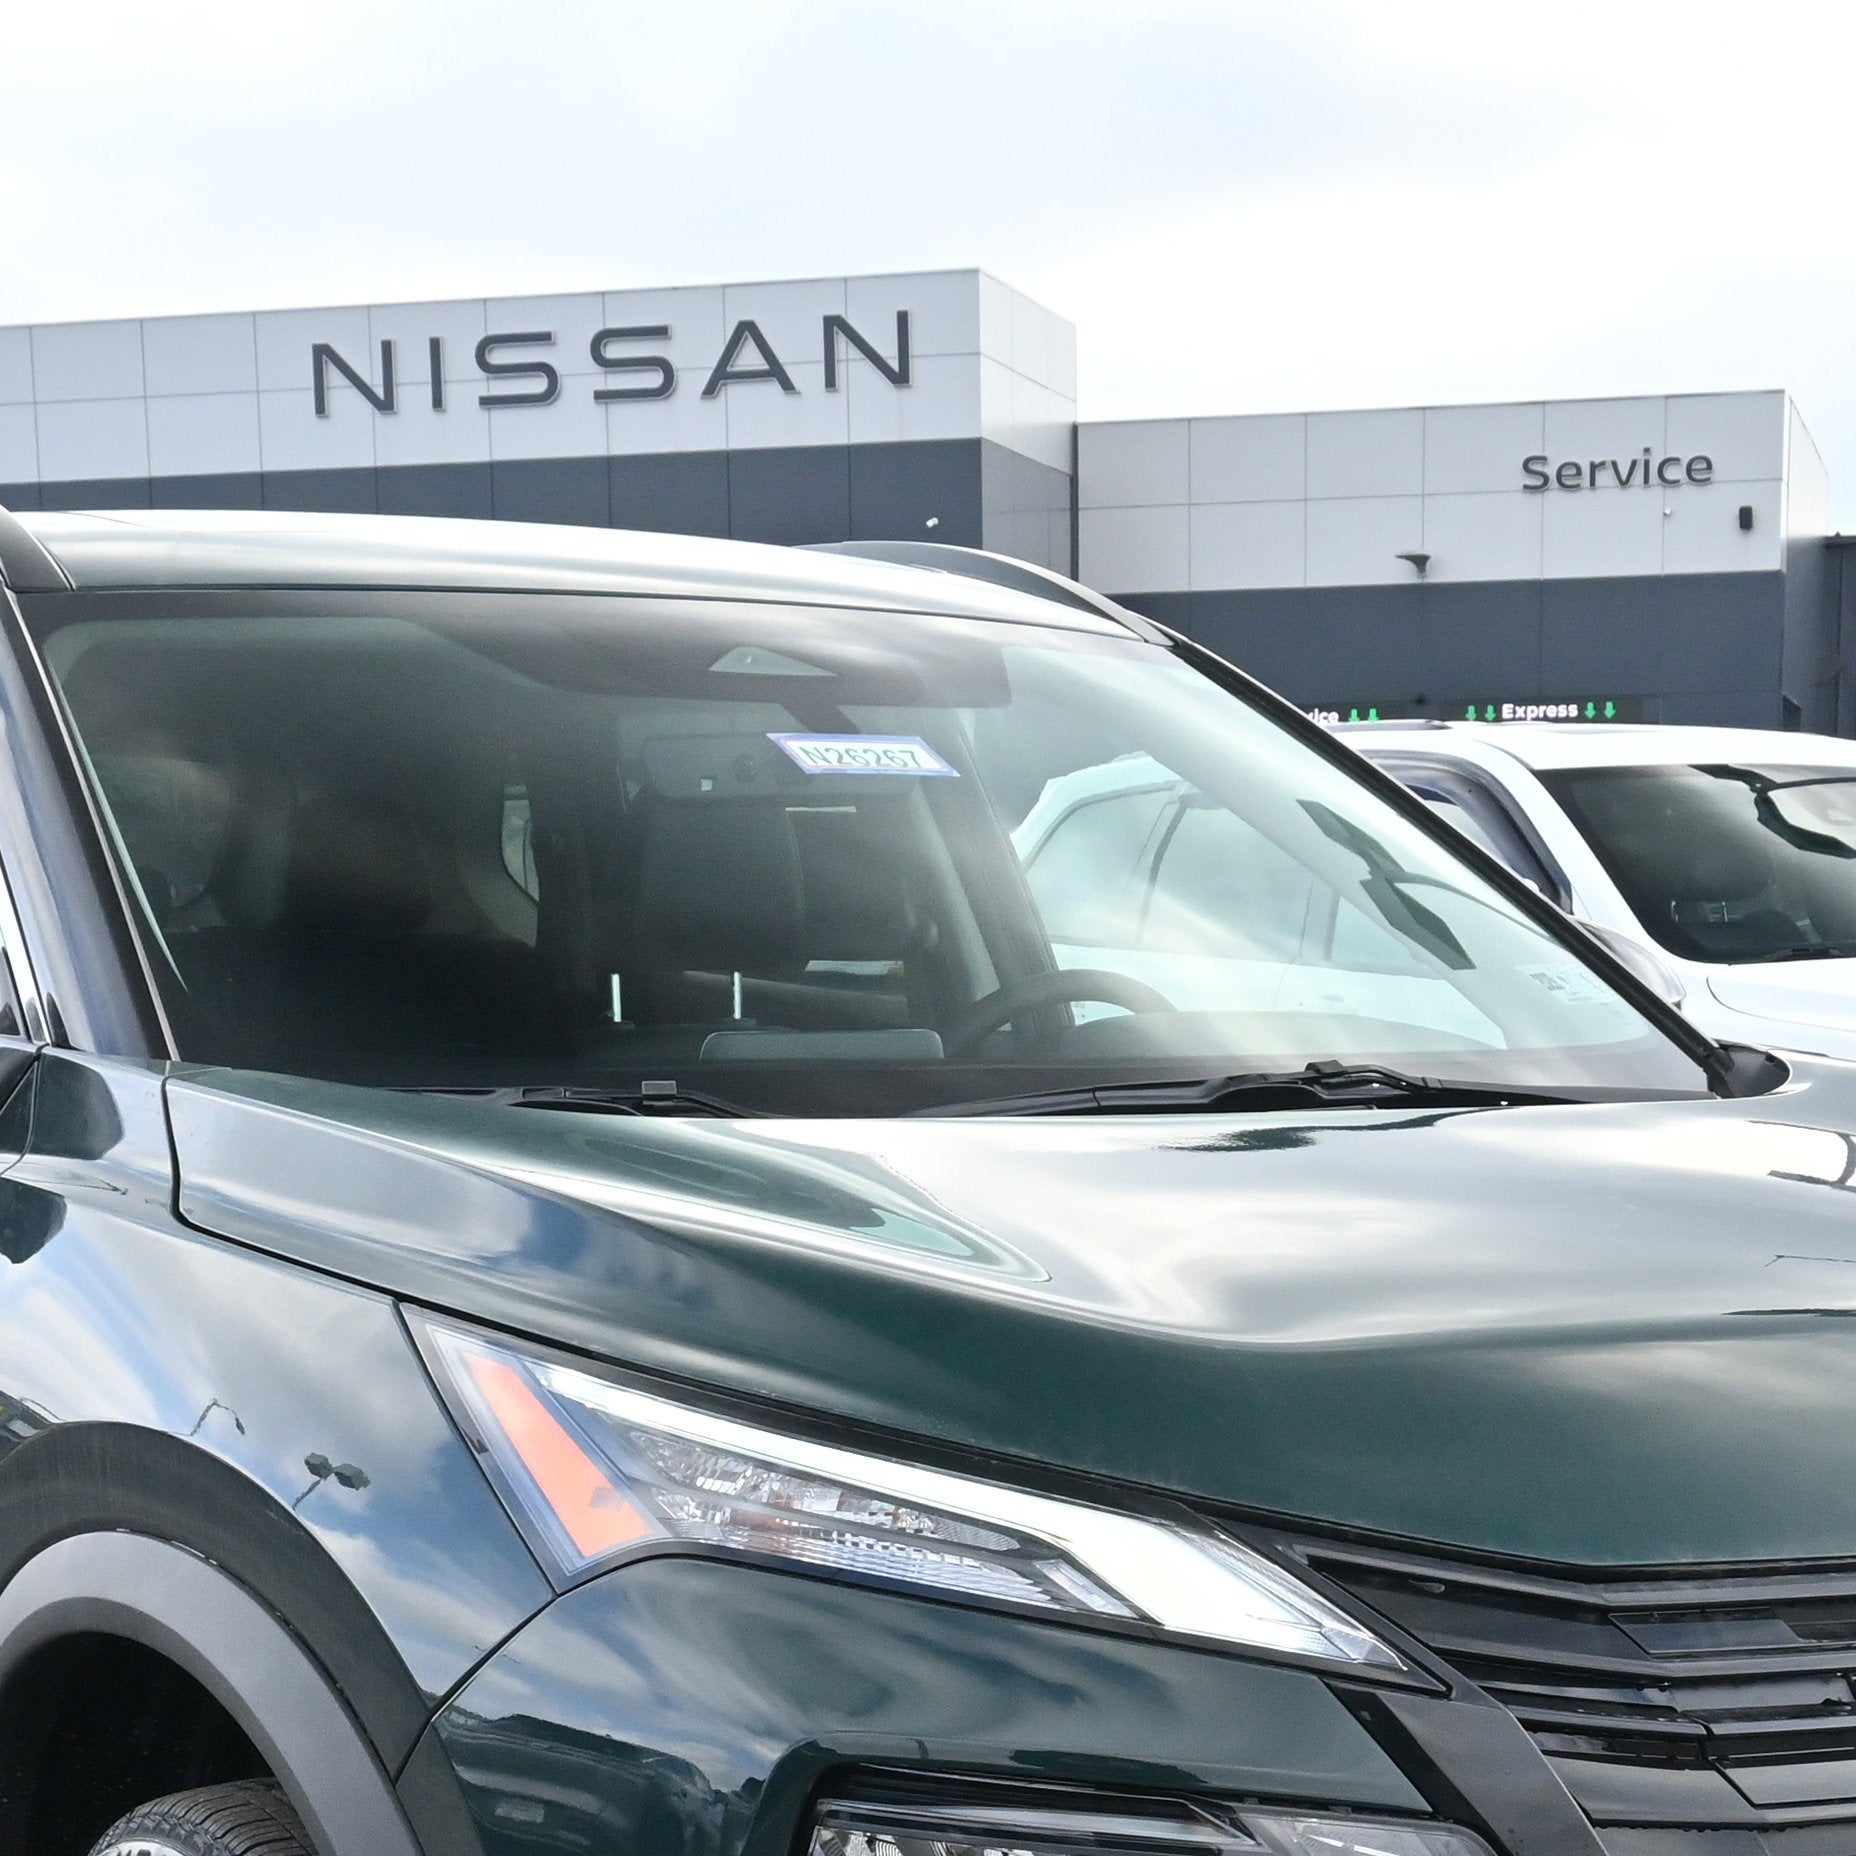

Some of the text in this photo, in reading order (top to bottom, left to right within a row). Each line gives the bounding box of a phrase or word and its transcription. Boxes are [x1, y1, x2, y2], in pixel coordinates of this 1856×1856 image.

[311, 309, 913, 418] NISSAN
[1521, 446, 1714, 492] Service
[1501, 702, 1580, 721] Express
[798, 745, 923, 769] N26267
